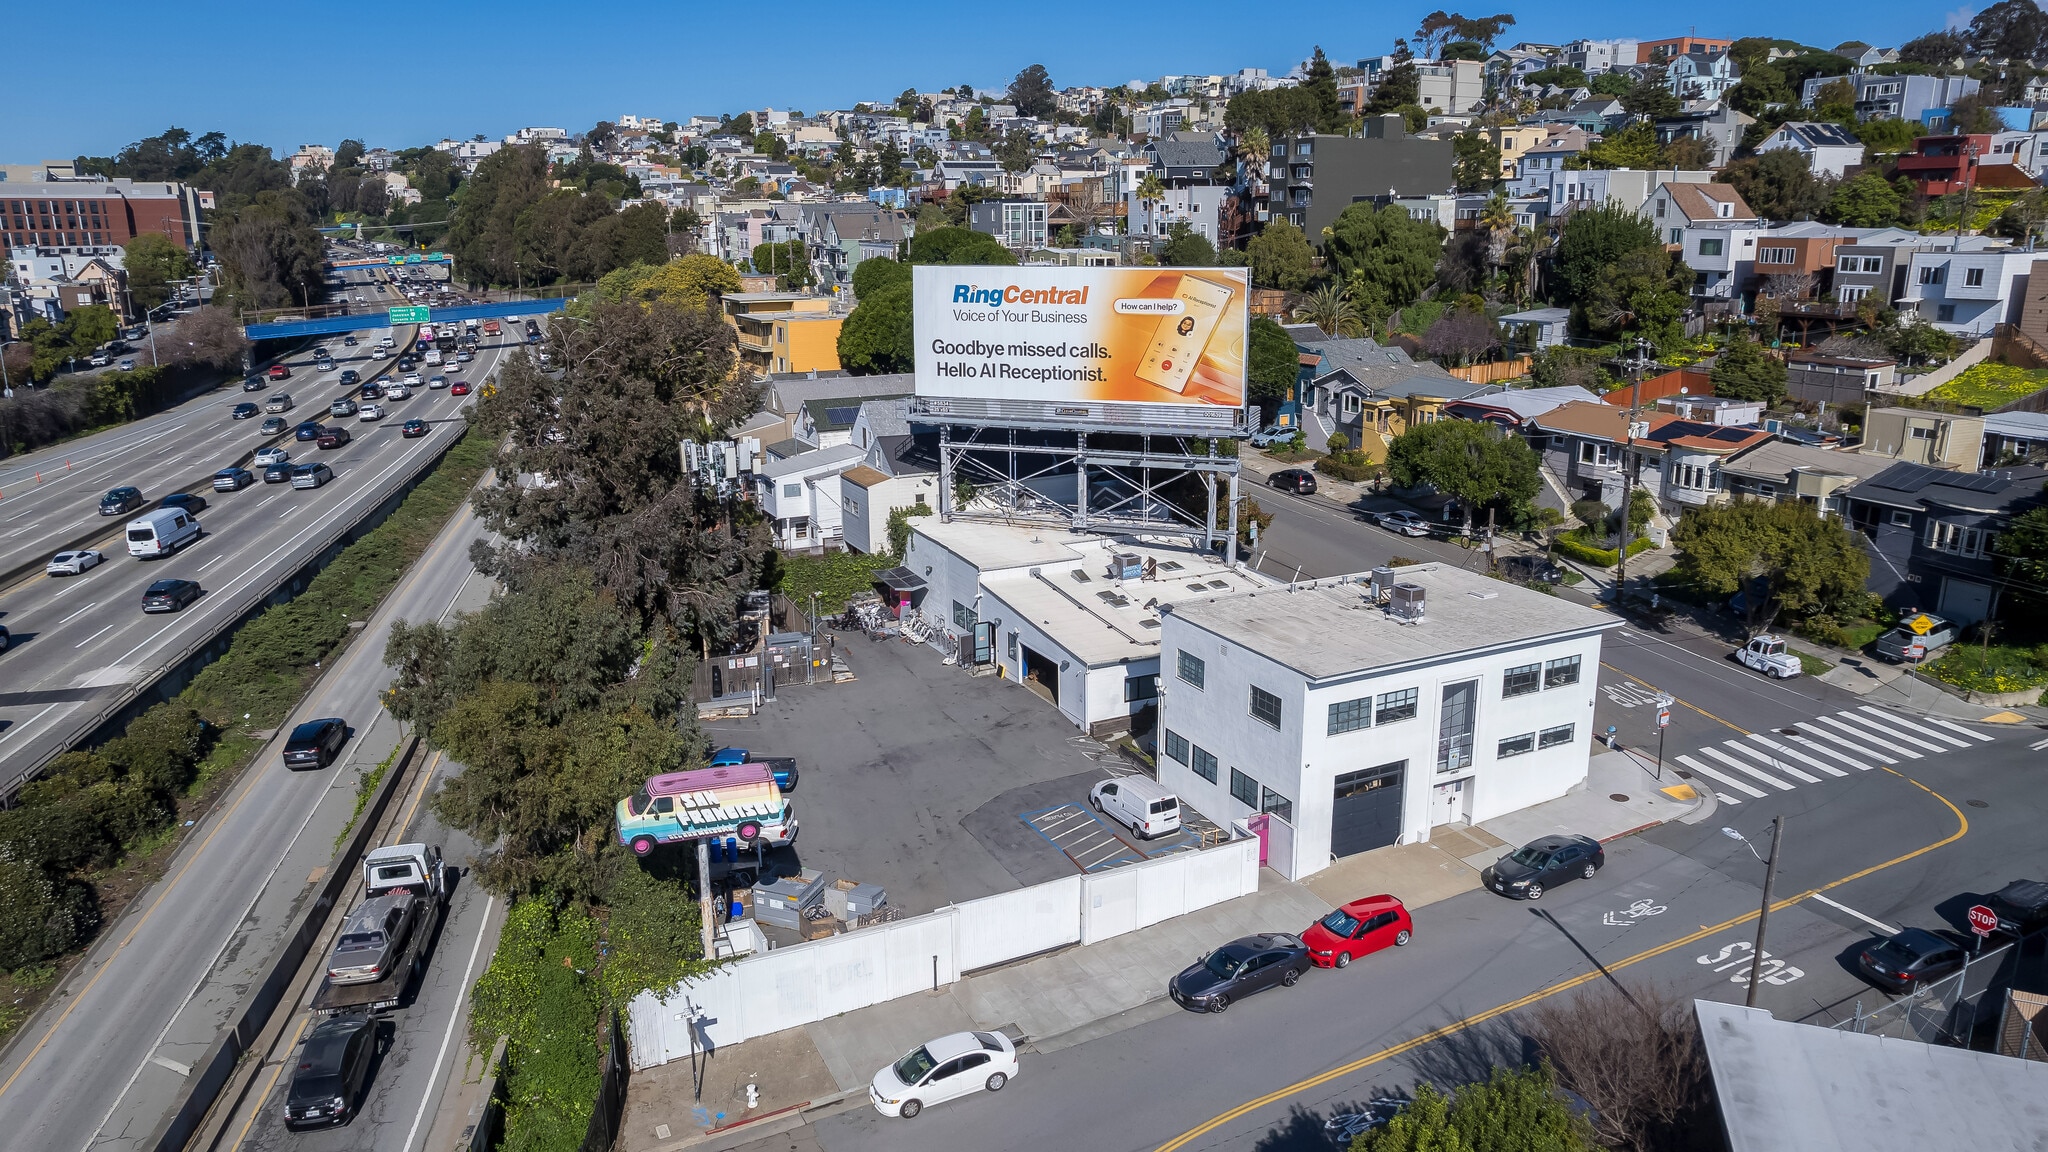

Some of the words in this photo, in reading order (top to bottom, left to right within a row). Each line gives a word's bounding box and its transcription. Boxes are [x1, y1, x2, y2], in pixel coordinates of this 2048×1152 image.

[953, 284, 1089, 307] RingCentral
[1193, 296, 1217, 309] Receptionist
[953, 309, 986, 321] Voice
[987, 310, 999, 322] of
[1000, 311, 1029, 323] Your
[1031, 311, 1087, 324] Business
[1121, 302, 1137, 311] How
[1156, 303, 1178, 313] help?
[932, 339, 1004, 358] Goodbye
[1008, 341, 1066, 357] missed
[1069, 343, 1112, 359] calls.
[937, 362, 976, 378] Hello
[980, 363, 996, 378] AI
[1000, 364, 1108, 383] Receptionist.
[680, 790, 720, 809] SAN
[676, 801, 781, 828] FRANCISCO
[1970, 910, 1996, 926] STOP
[1696, 941, 1805, 989] STOP
